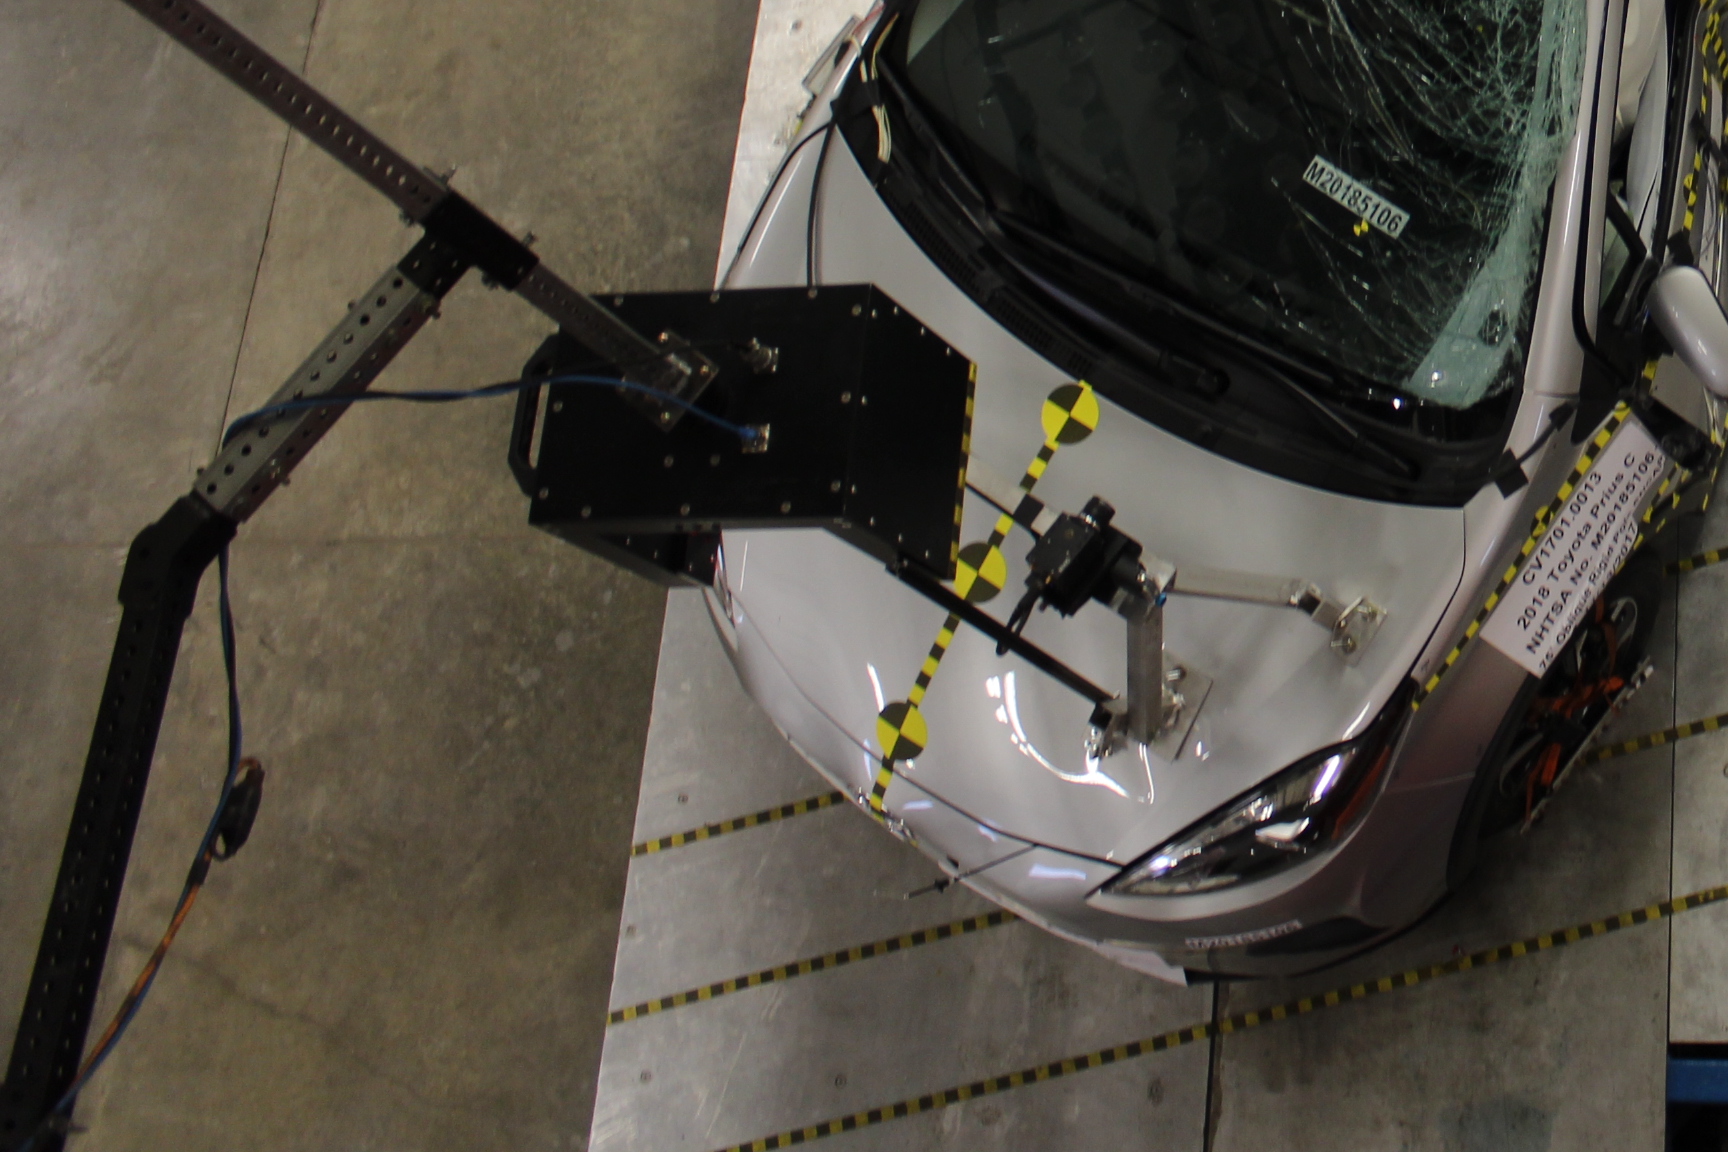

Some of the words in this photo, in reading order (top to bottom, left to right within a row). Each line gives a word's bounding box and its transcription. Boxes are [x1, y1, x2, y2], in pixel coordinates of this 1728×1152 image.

[1305, 161, 1403, 233] M20185106
[1517, 585, 1551, 631] 2018
[1547, 523, 1592, 582] Toyota
[1590, 472, 1625, 520] Prius
[1623, 452, 1636, 468] C
[1522, 470, 1602, 586] CV1701.0013
[1526, 589, 1573, 655] NHTSA
[1569, 554, 1594, 586] No.
[1591, 453, 1656, 551] M20185106
[1556, 588, 1592, 646] Oblique
[1589, 543, 1614, 582] Rigid
